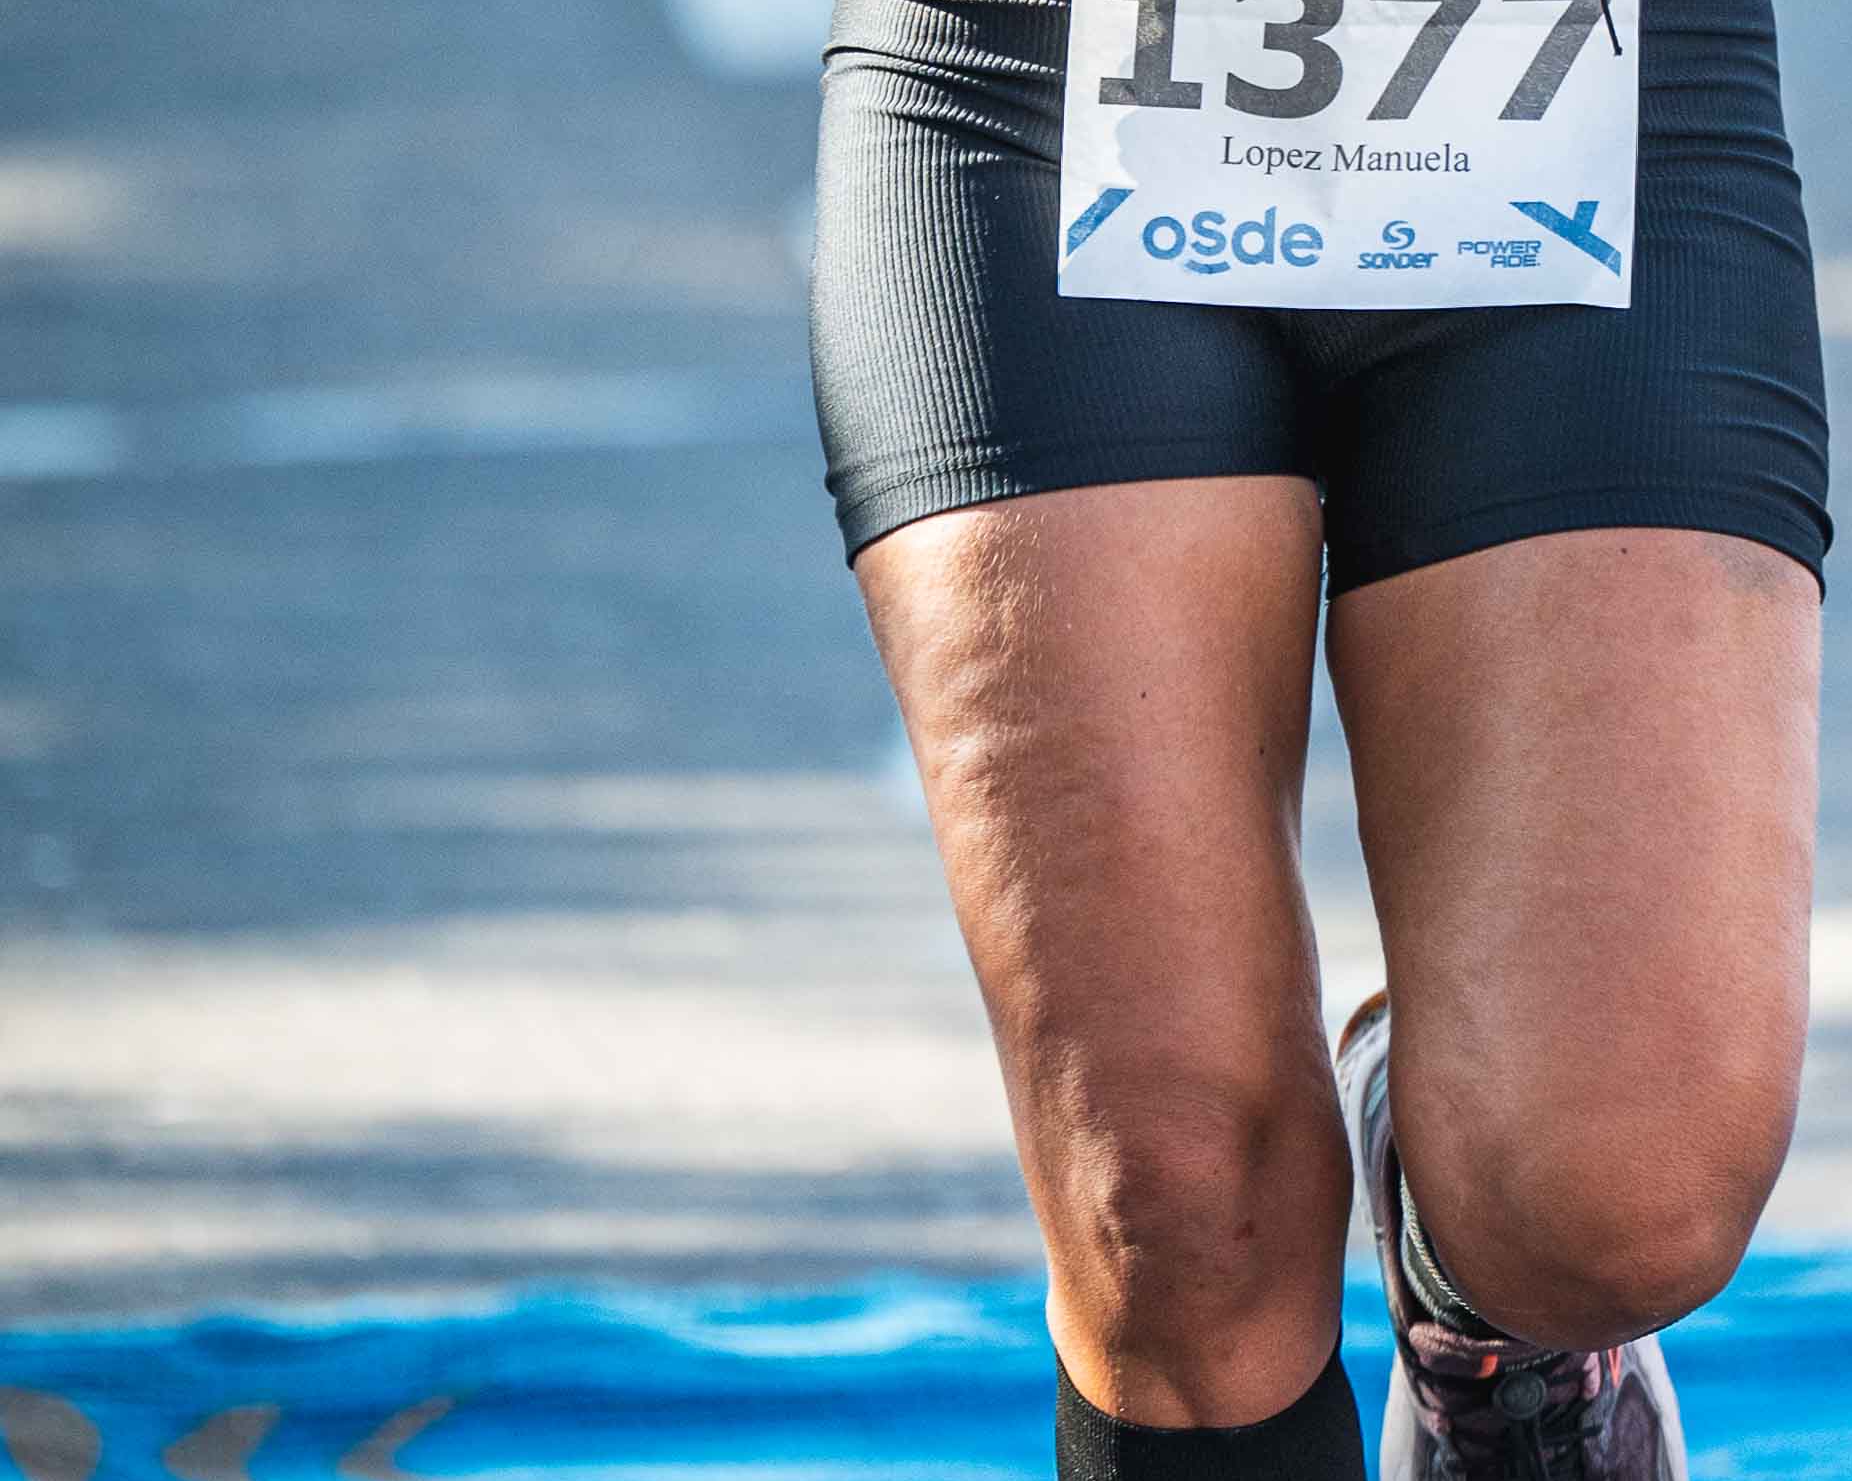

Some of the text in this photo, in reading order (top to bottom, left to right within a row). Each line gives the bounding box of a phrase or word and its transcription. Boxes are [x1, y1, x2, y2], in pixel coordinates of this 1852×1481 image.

[1221, 135, 1472, 175] Lopez Manuela
[1142, 206, 1324, 268] osde
[1457, 239, 1542, 255] POWER
